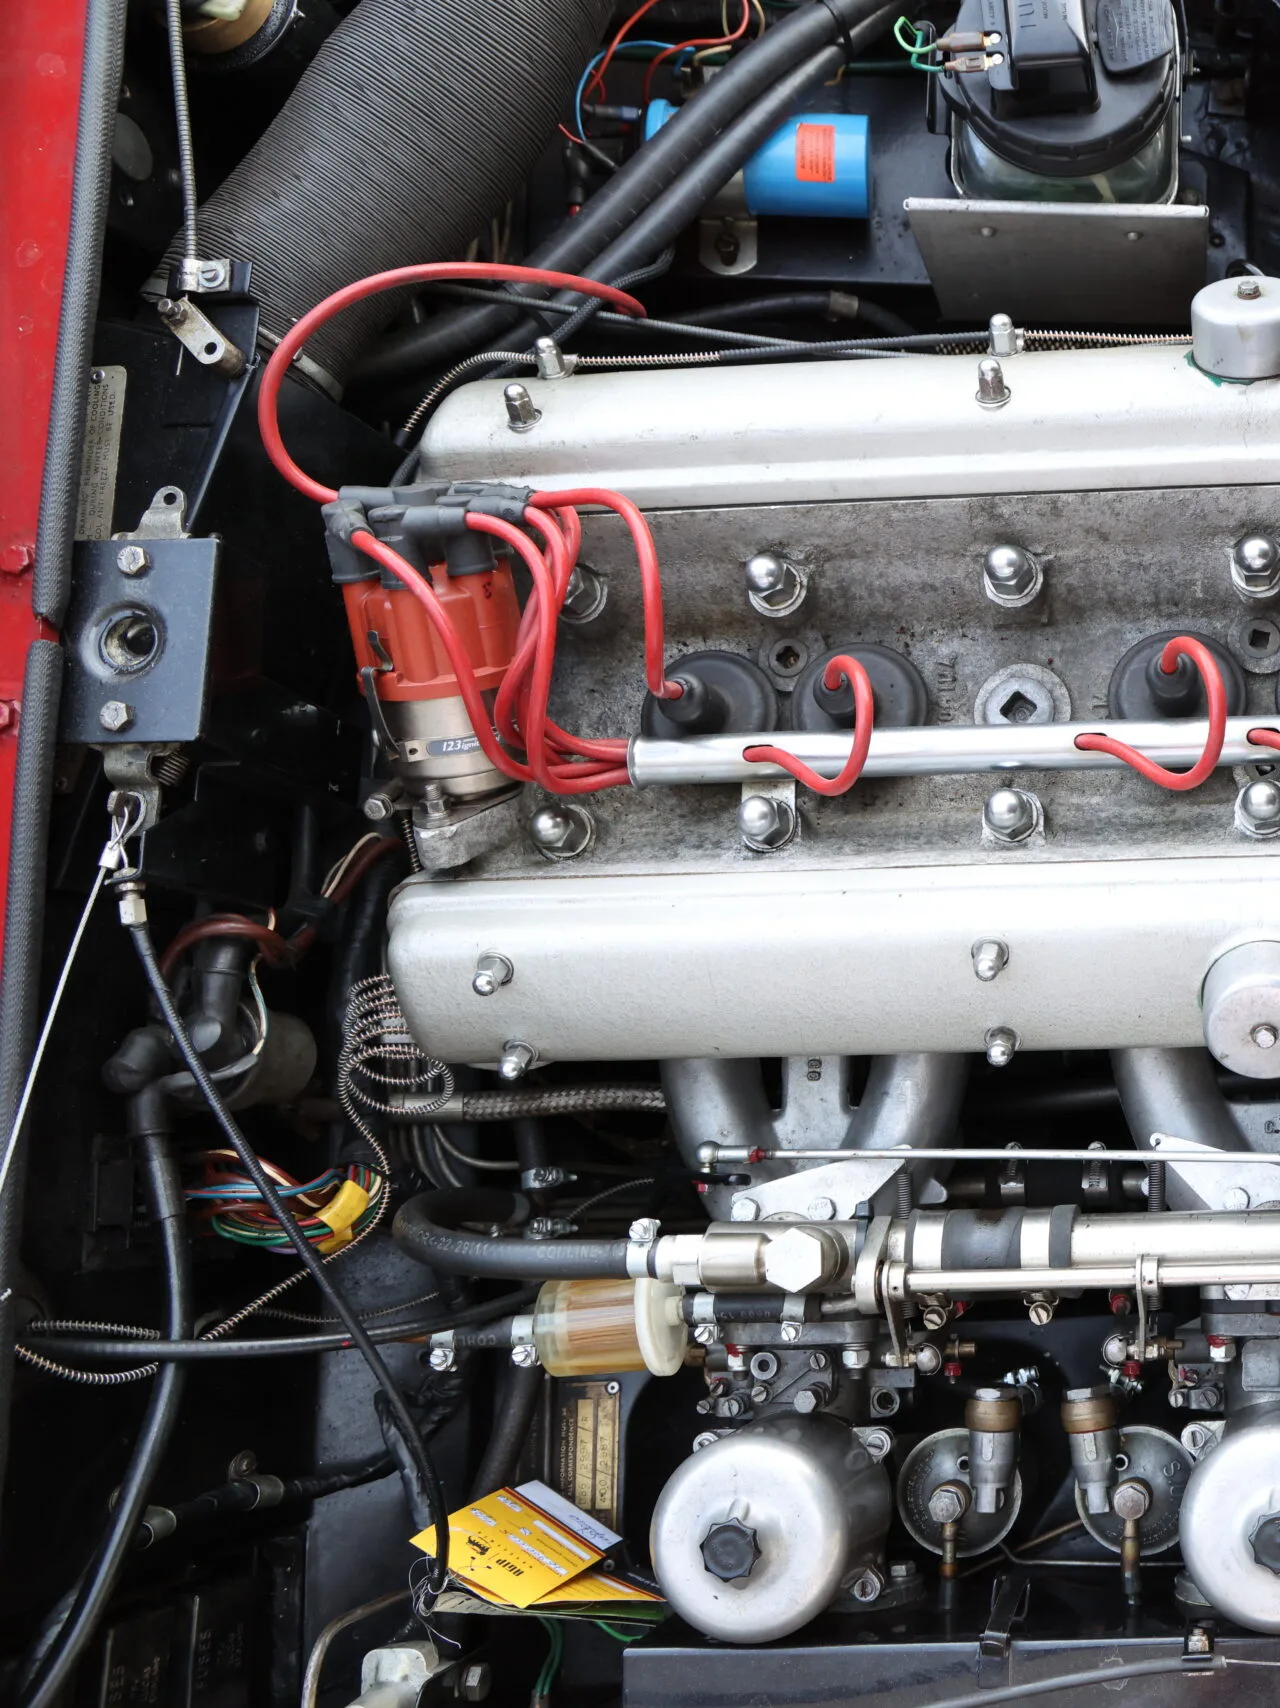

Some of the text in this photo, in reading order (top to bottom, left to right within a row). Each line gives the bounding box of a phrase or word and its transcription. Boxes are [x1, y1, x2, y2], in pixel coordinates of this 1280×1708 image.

[83, 440, 94, 486] REMAINDER
[90, 384, 101, 422] COOLING
[105, 422, 113, 432] BE
[88, 482, 98, 516] DURING
[97, 383, 109, 435] CONDITIONS
[103, 439, 111, 460] MUST
[99, 465, 109, 495] FREEZE
[442, 740, 462, 752] 123
[495, 1558, 525, 1577] AGIP
